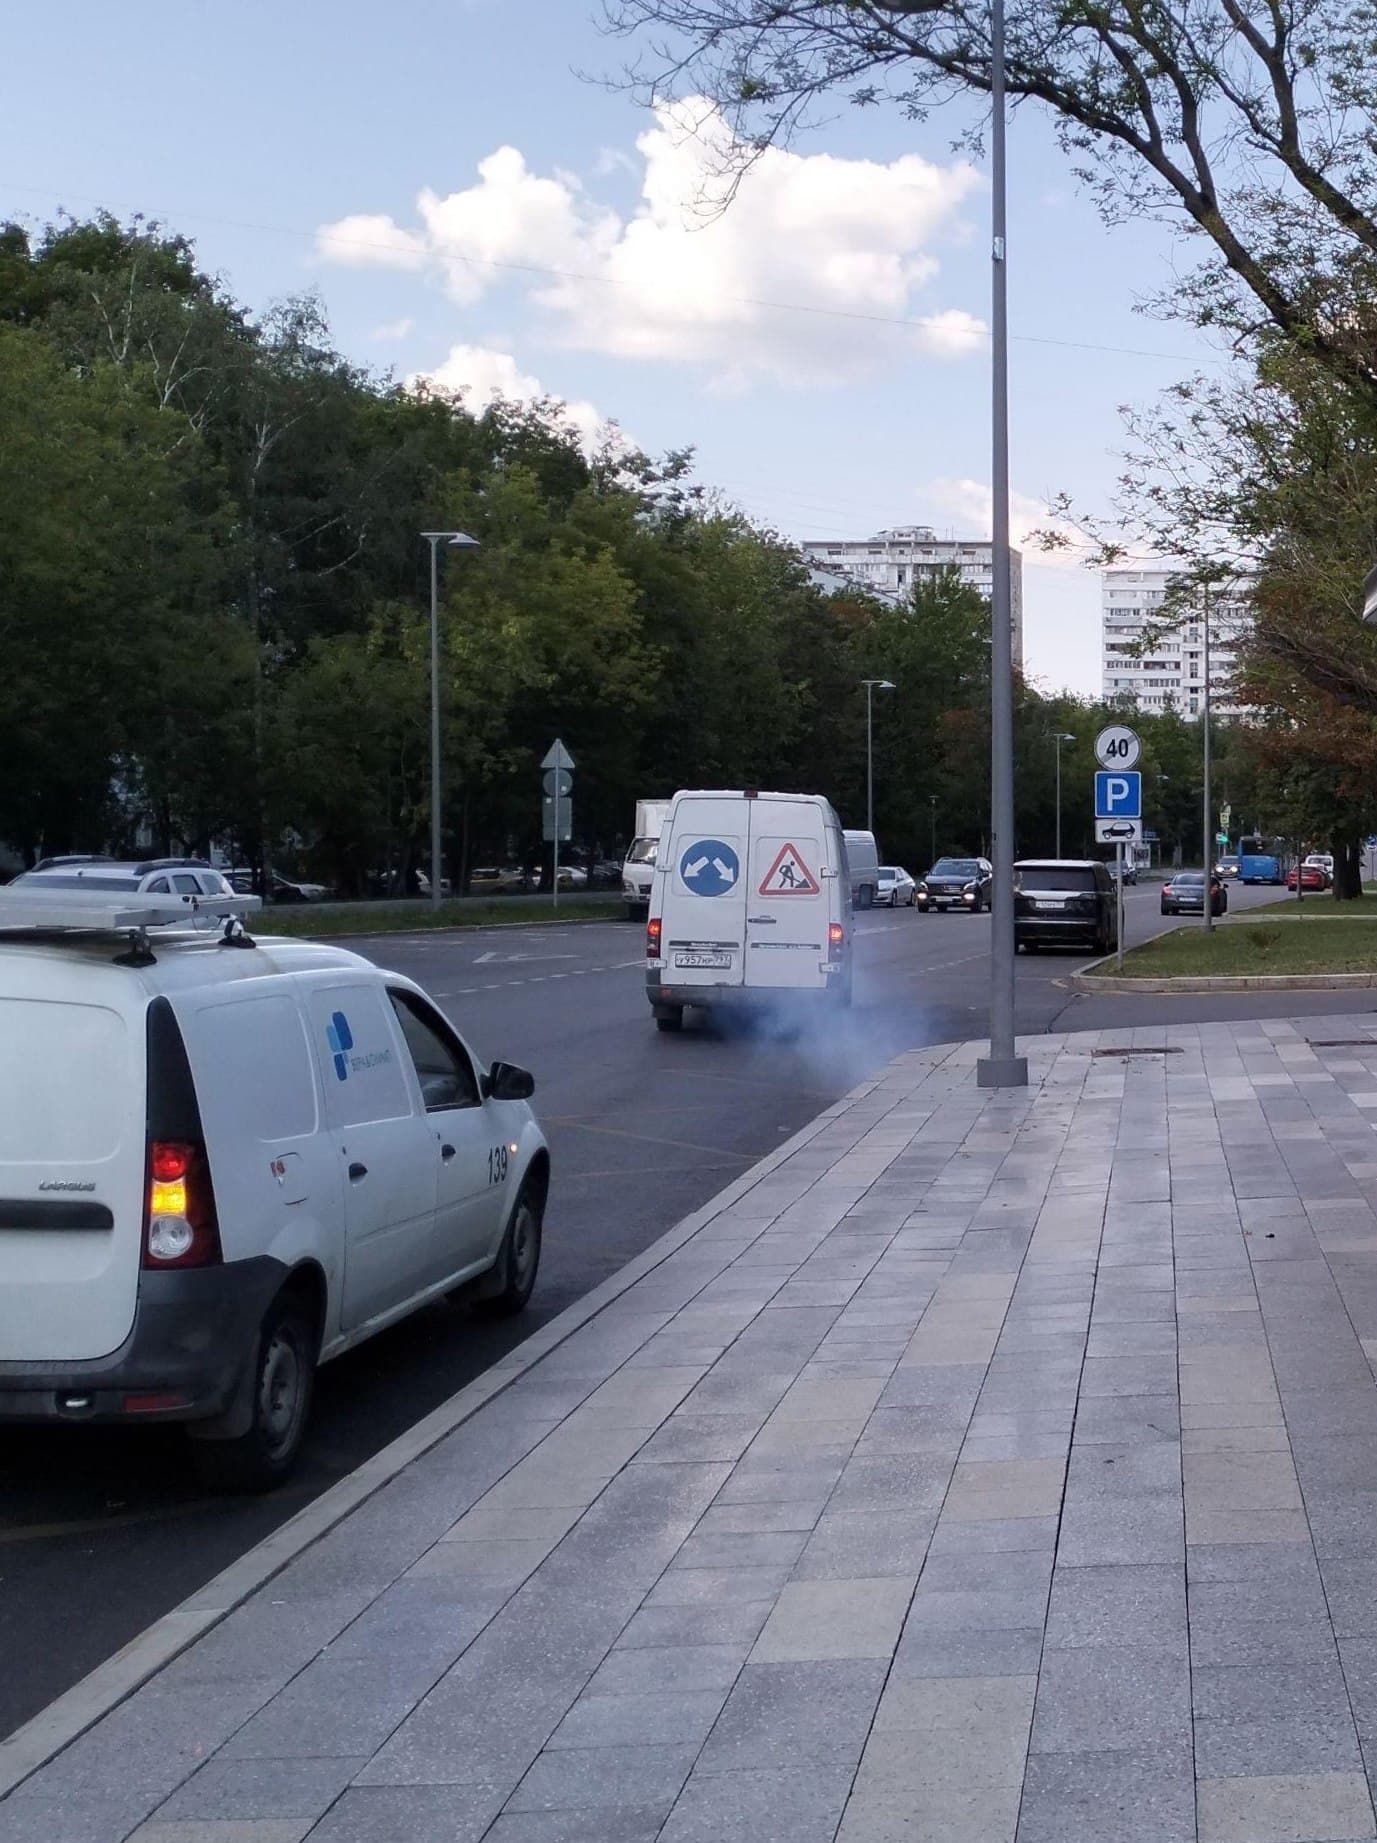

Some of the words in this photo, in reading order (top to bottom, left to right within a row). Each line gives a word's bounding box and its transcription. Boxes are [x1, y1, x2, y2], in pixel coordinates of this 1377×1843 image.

[1106, 738, 1129, 758] 40
[1107, 778, 1130, 811] P
[488, 1146, 508, 1184] 139
